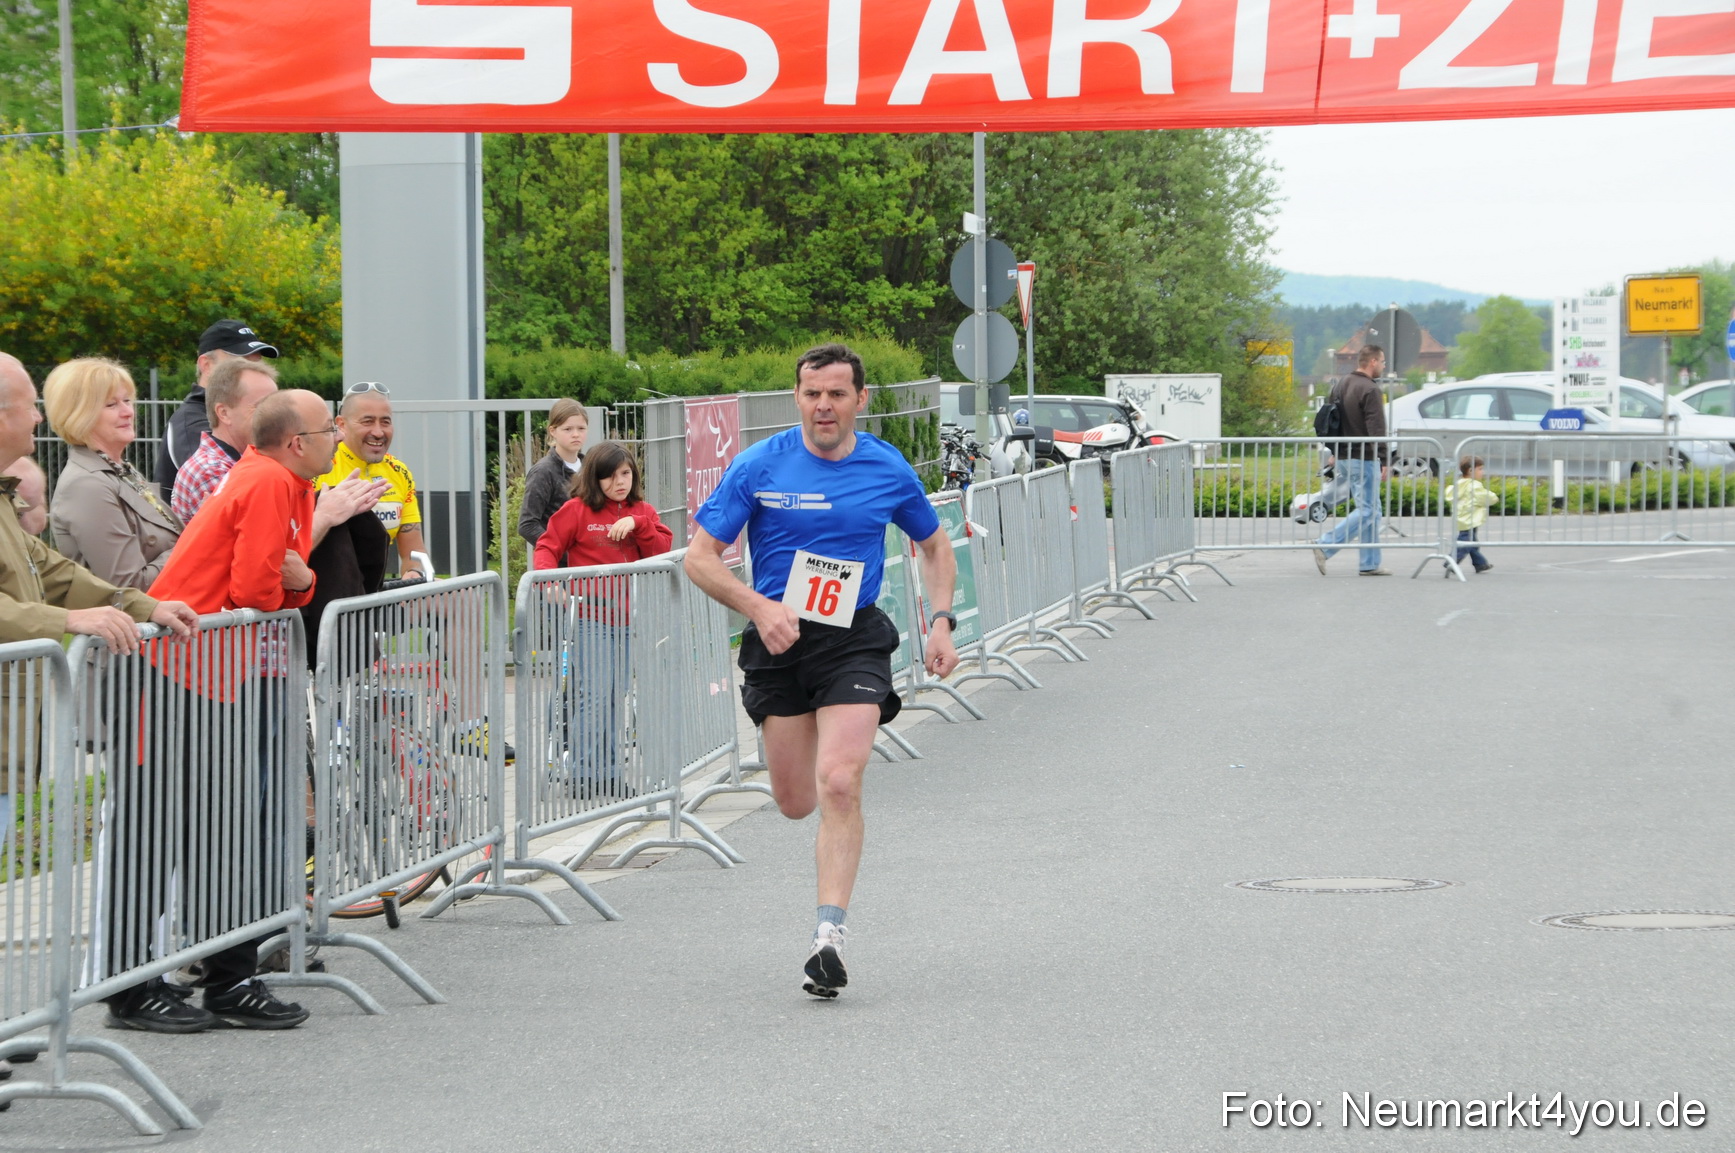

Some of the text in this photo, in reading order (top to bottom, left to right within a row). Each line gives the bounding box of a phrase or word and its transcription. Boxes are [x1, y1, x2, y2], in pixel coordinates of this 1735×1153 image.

[1635, 297, 1693, 311] Neumarkt
[1549, 417, 1580, 430] VOLVO
[805, 564, 838, 577] WERBUNG
[806, 557, 840, 572] MEYER
[805, 576, 842, 617] 16
